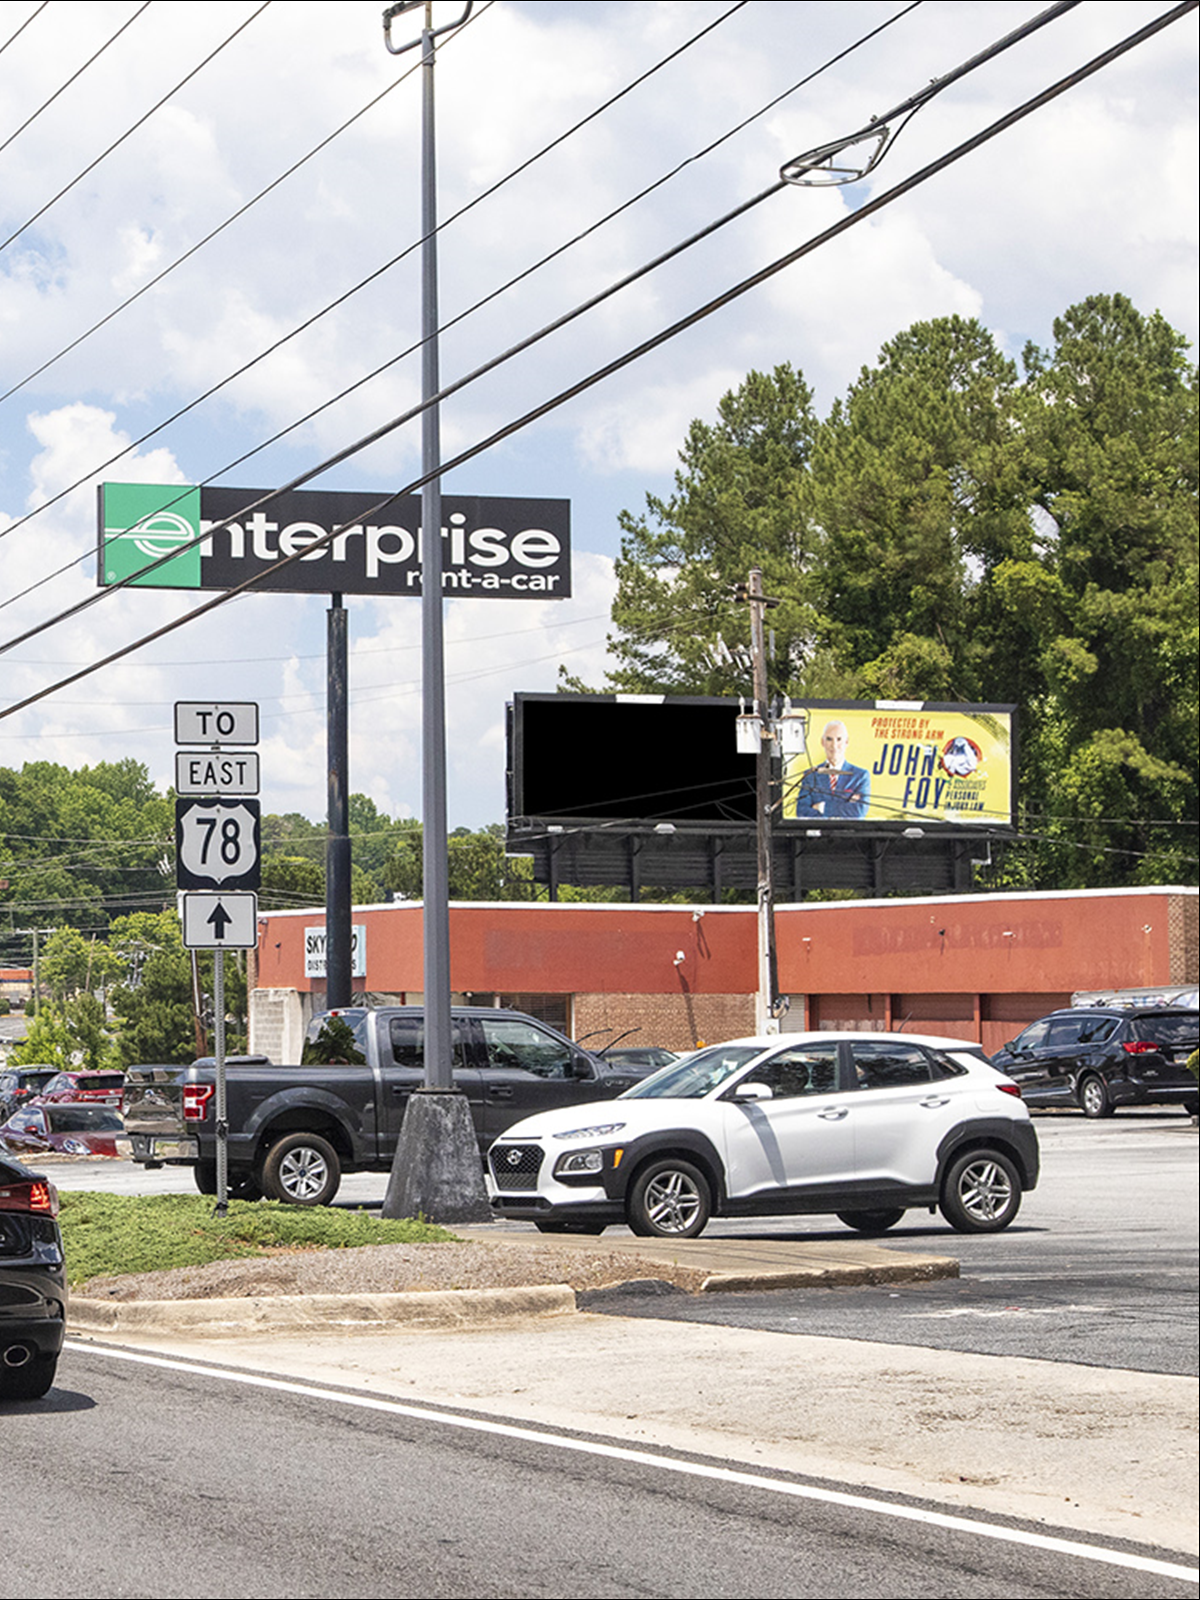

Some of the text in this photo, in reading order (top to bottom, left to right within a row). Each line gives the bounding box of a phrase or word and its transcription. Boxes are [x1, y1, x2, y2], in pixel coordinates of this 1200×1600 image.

[407, 569, 559, 591] rnt-a-car
[196, 711, 235, 735] TO
[871, 717, 931, 728] PROTECTED BY
[874, 728, 945, 740] THE STRONG ARM
[872, 743, 938, 776] JOHN
[189, 761, 247, 785] EAST
[902, 777, 947, 810] FOY
[196, 818, 240, 865] 78
